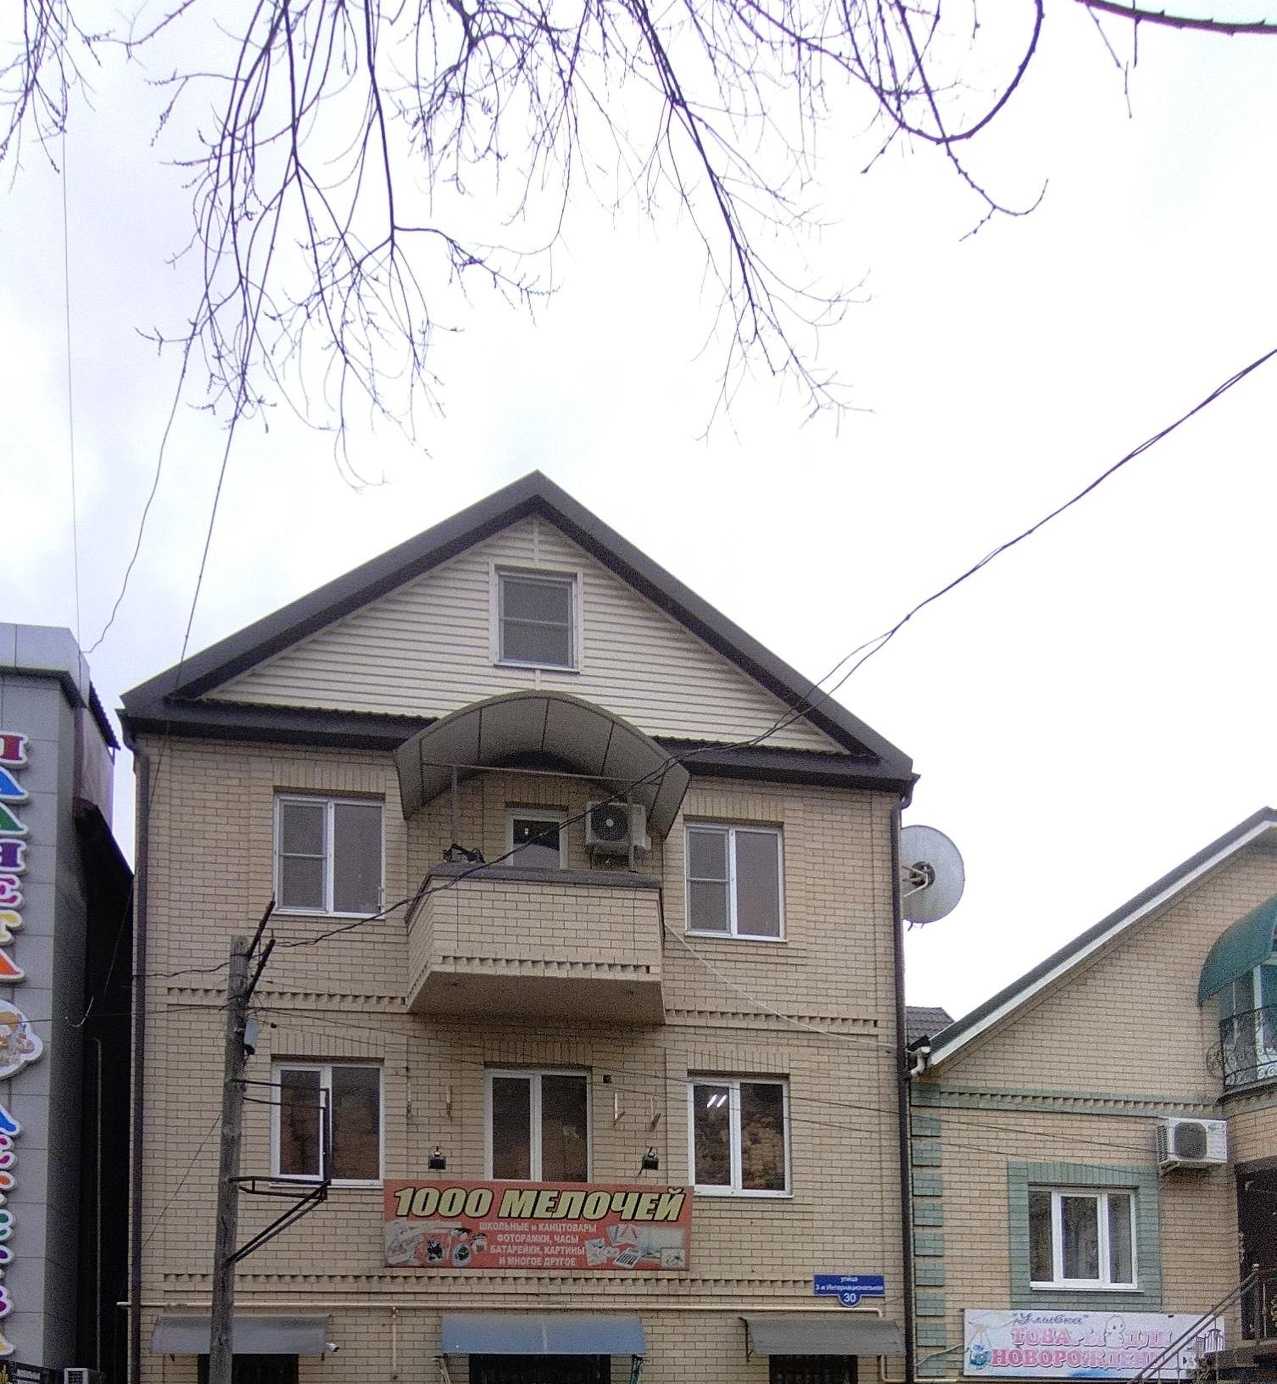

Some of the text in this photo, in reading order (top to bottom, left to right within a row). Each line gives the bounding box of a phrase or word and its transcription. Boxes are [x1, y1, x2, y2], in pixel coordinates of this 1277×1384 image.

[394, 1186, 686, 1222] 1000 МЕЛОЧЕЙ
[479, 1222, 529, 1231] ШКОЛЬНЫЕ
[539, 1223, 597, 1232] КАНЦТОВАРЫ
[554, 1235, 579, 1244] ЧАСЫ
[544, 1246, 585, 1255] КАРТИНЫ
[507, 1257, 542, 1266] МНОГОЕ
[544, 1257, 577, 1267] ДРУГОЕ
[843, 1293, 857, 1302] 30
